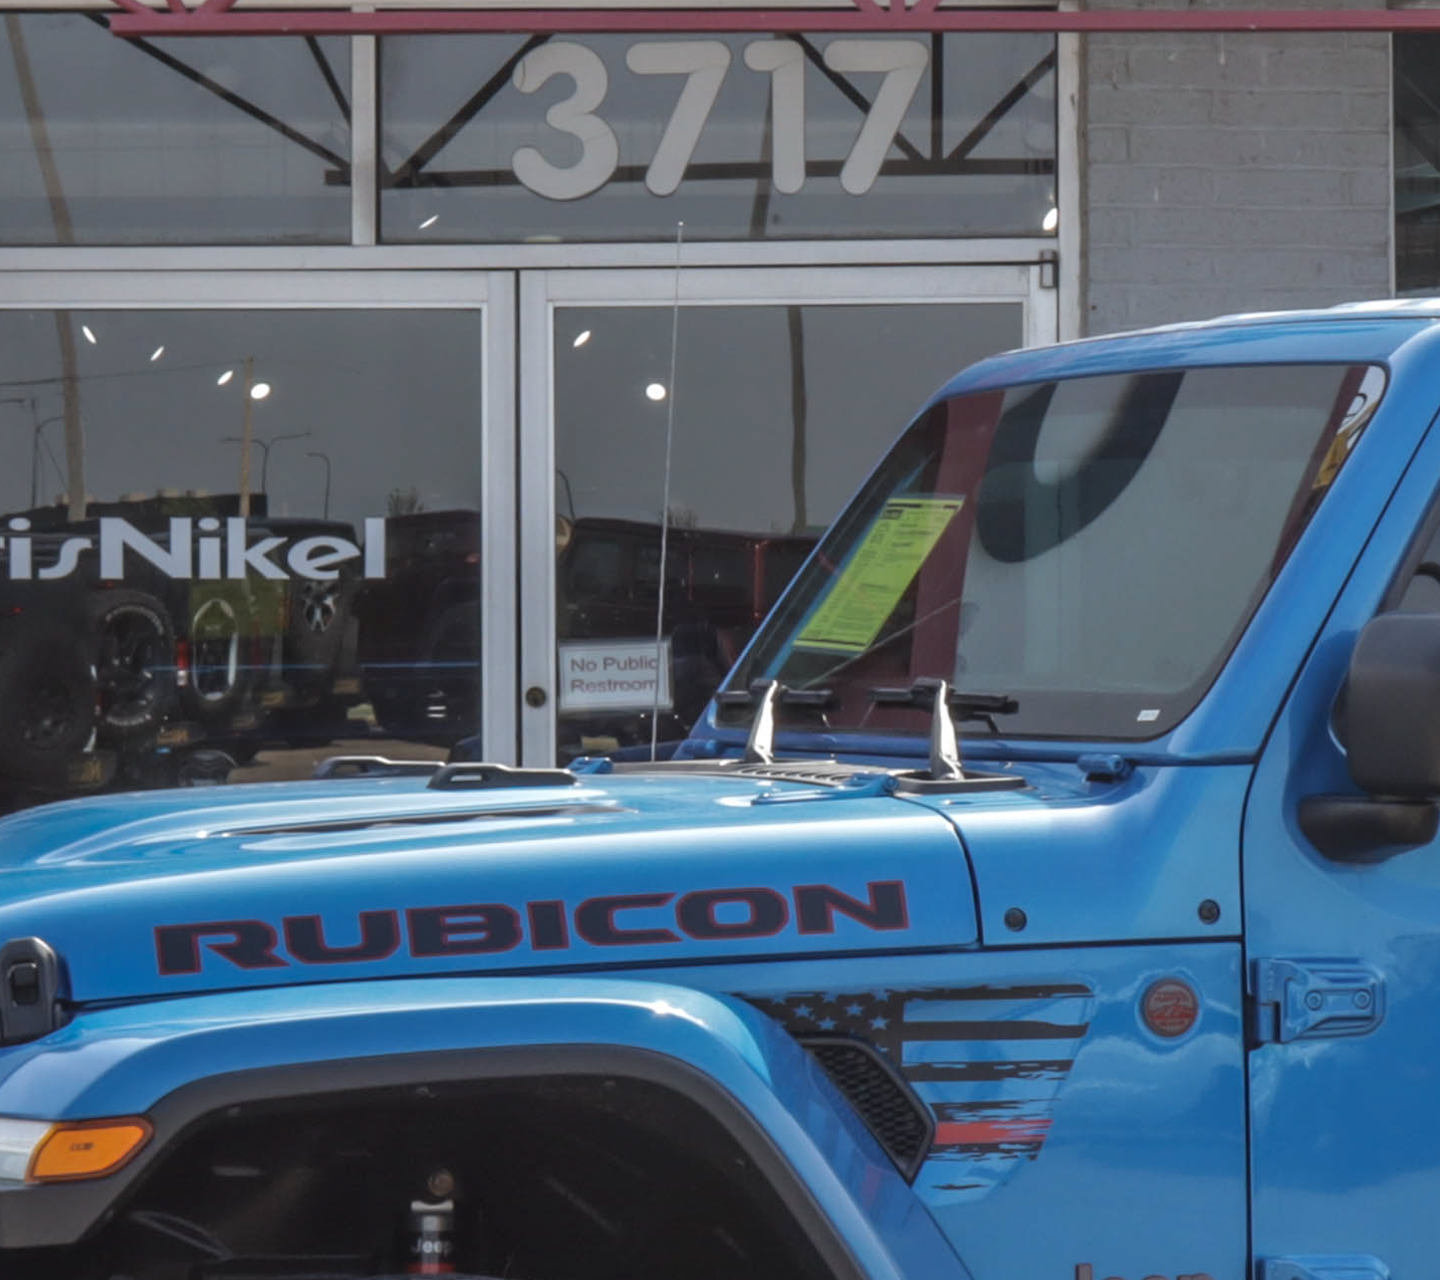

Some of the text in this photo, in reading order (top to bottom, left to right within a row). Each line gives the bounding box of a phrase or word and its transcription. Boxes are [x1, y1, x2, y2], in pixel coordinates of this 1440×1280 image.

[511, 39, 930, 201] 3717
[570, 655, 658, 672] No Public
[154, 879, 910, 975] RUBICON
